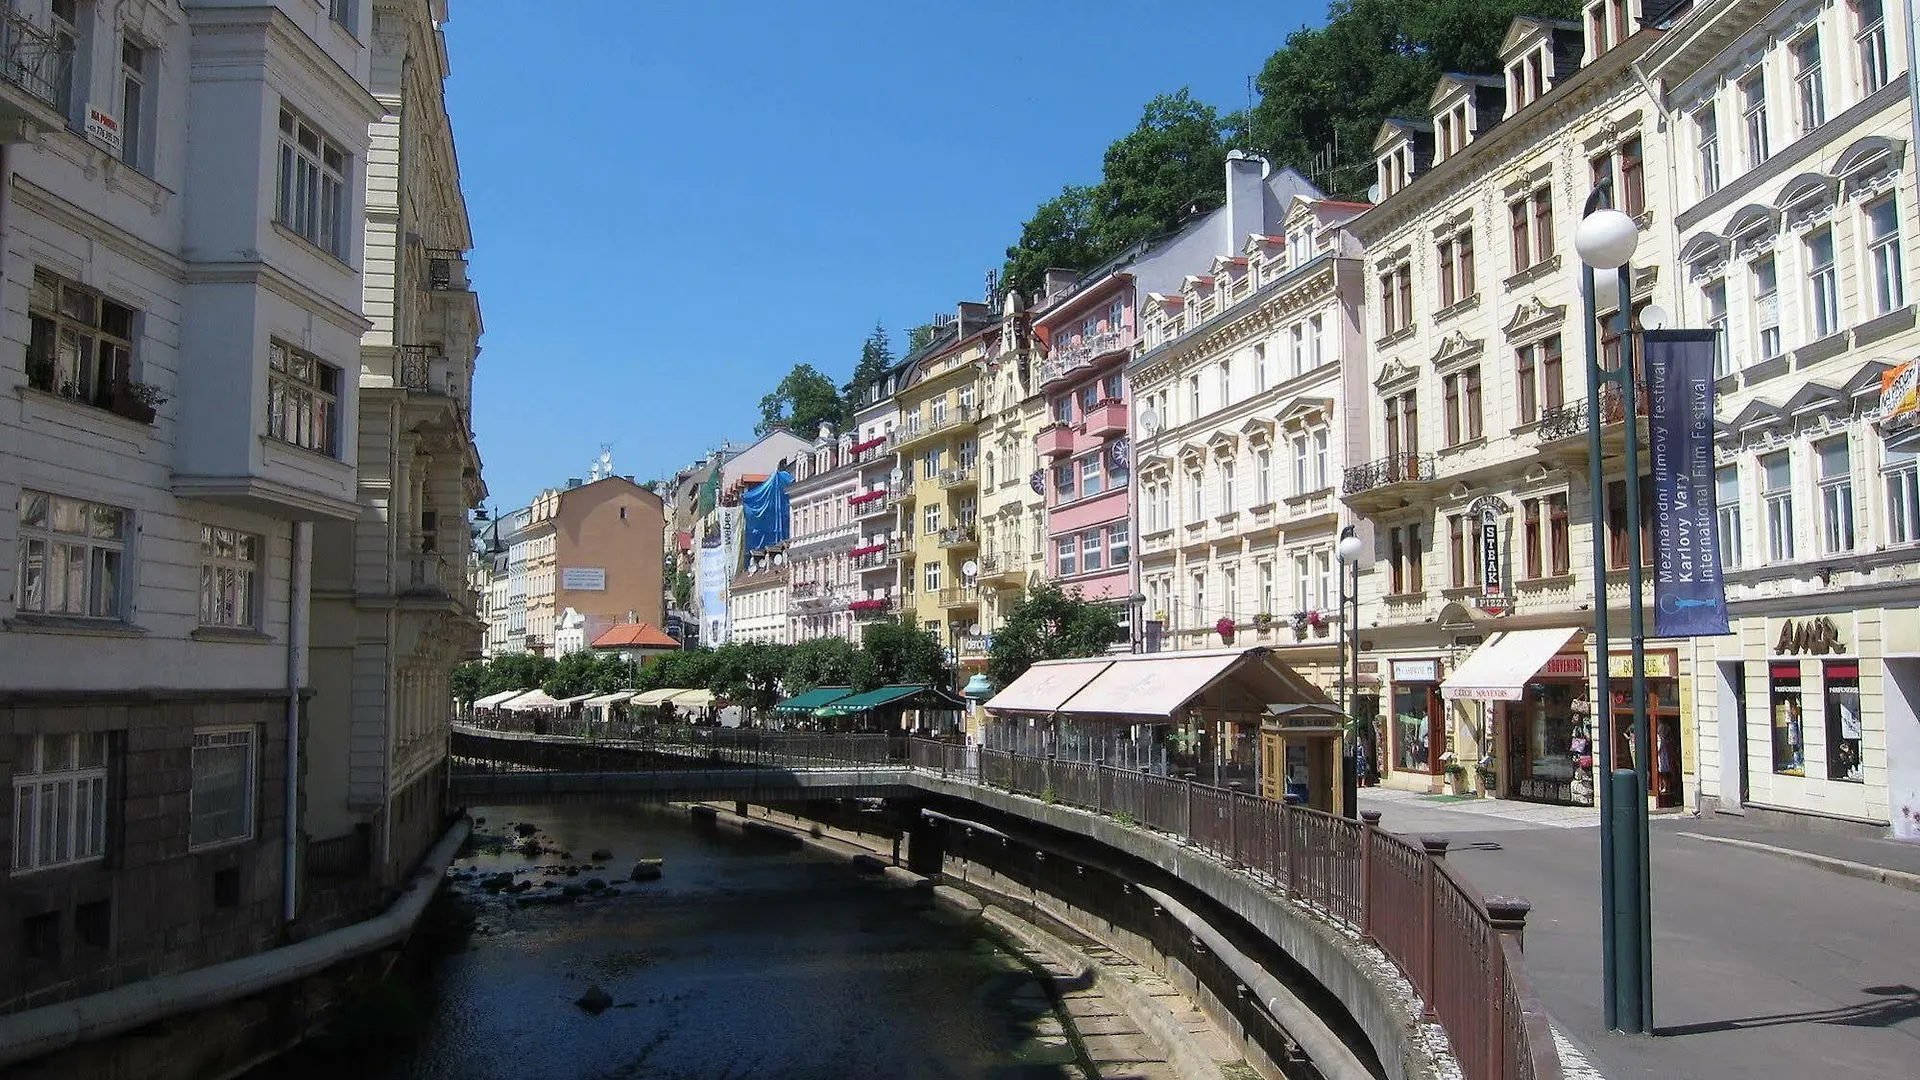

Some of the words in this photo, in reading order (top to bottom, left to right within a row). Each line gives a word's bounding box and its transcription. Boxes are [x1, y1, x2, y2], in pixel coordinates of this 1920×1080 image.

[1653, 362, 1666, 419] festival
[1691, 379, 1706, 439] Festival
[1692, 446, 1707, 477] Film
[1674, 472, 1689, 511] Vary
[723, 512, 732, 545] weber
[1486, 527, 1498, 583] STEAK
[1677, 518, 1693, 582] Karlovy
[1693, 485, 1714, 582] International
[1479, 599, 1509, 607] PIZZA
